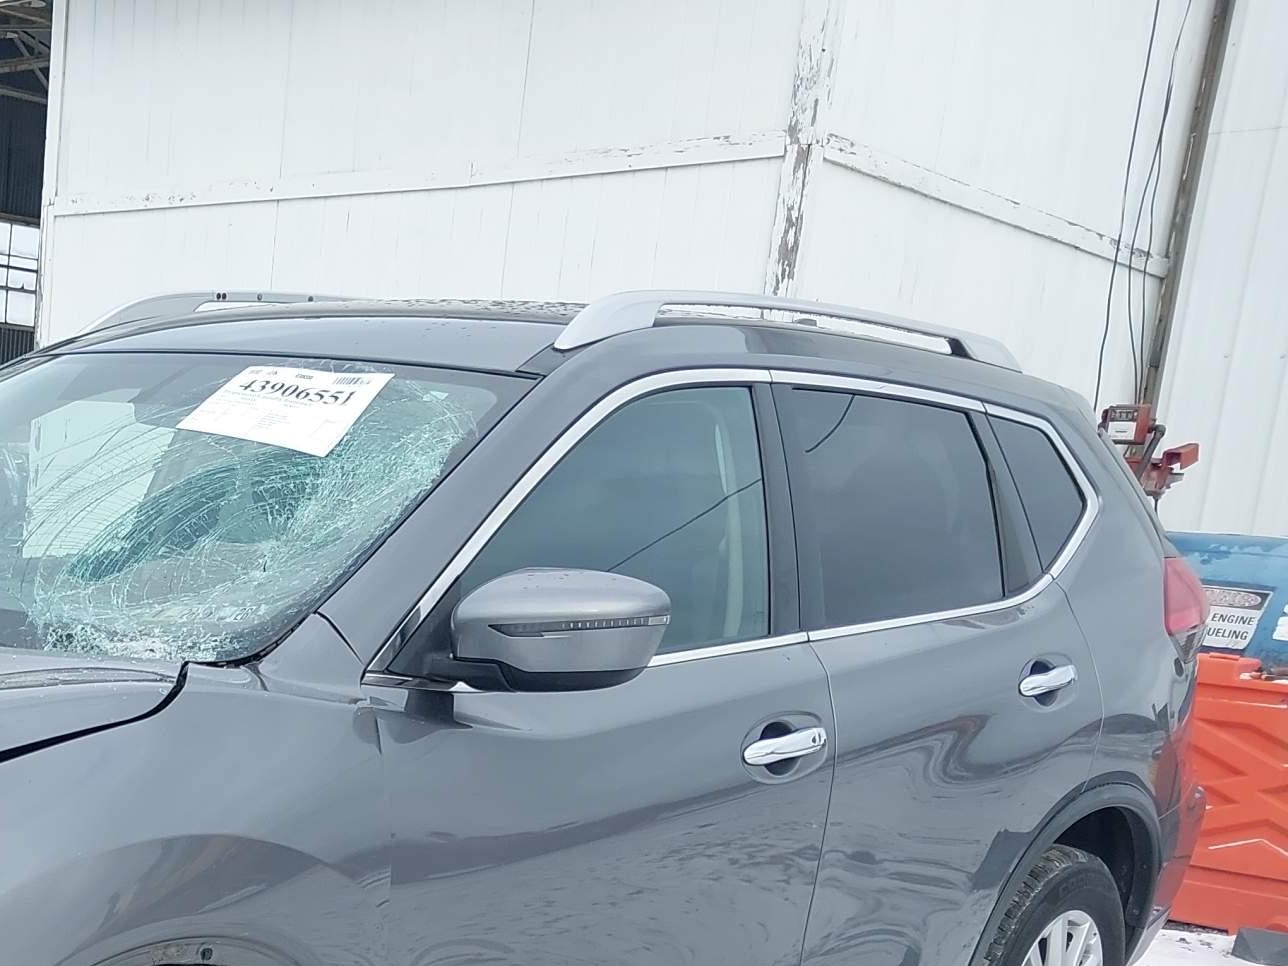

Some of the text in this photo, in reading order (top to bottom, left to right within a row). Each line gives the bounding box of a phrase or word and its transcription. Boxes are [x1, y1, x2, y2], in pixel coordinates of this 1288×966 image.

[239, 379, 357, 406] 43906551
[1211, 612, 1257, 626] ENGINE
[1206, 627, 1250, 641] UELING
